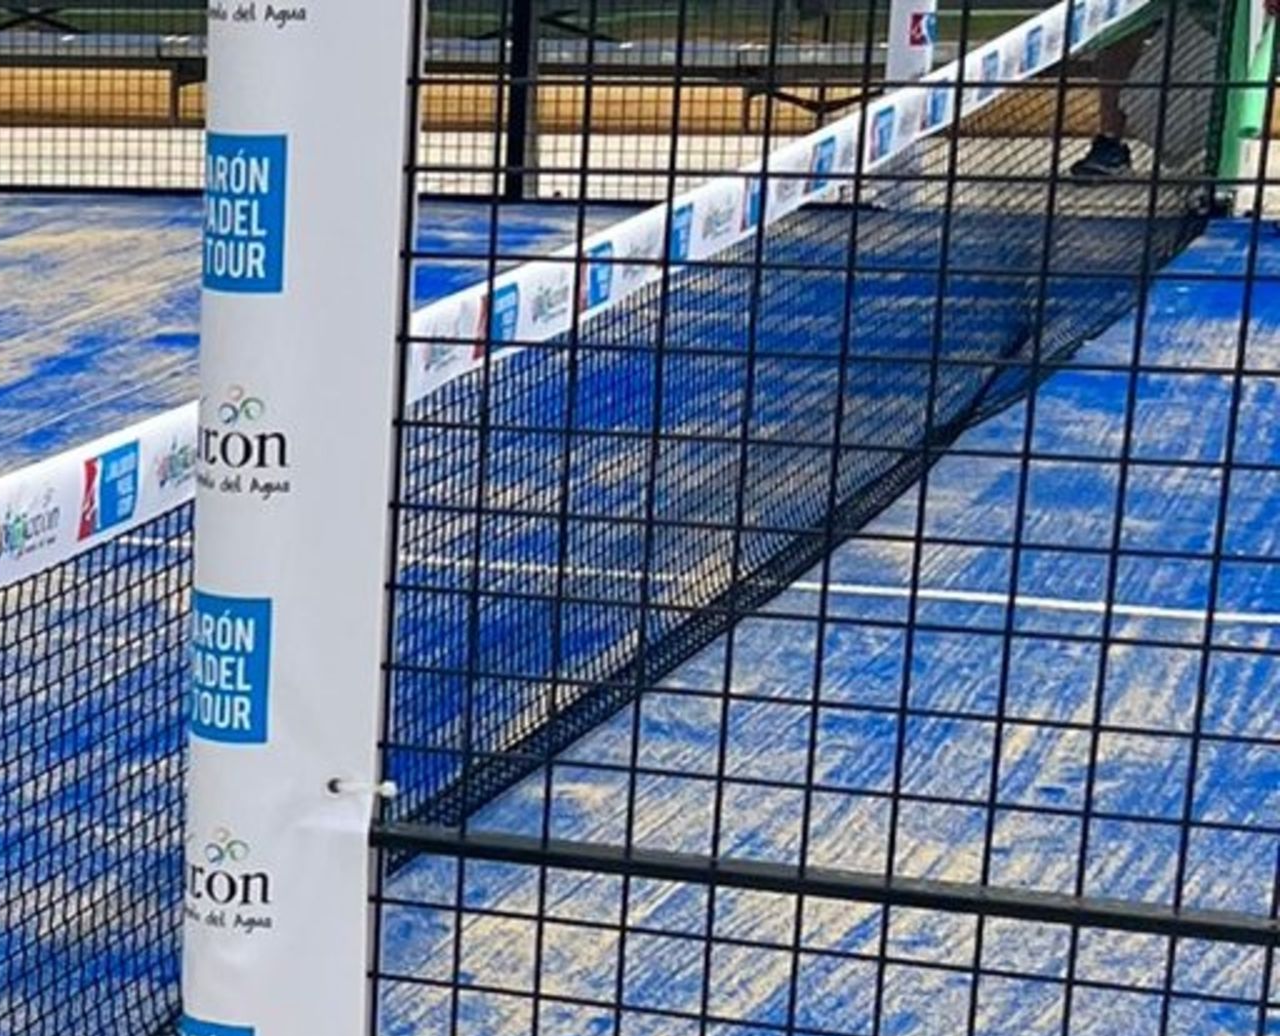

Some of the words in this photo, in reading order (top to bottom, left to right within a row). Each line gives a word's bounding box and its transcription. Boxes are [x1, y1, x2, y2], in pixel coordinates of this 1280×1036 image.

[264, 4, 307, 29] Agua
[205, 196, 267, 237] ADEL
[191, 645, 253, 691] ADEL
